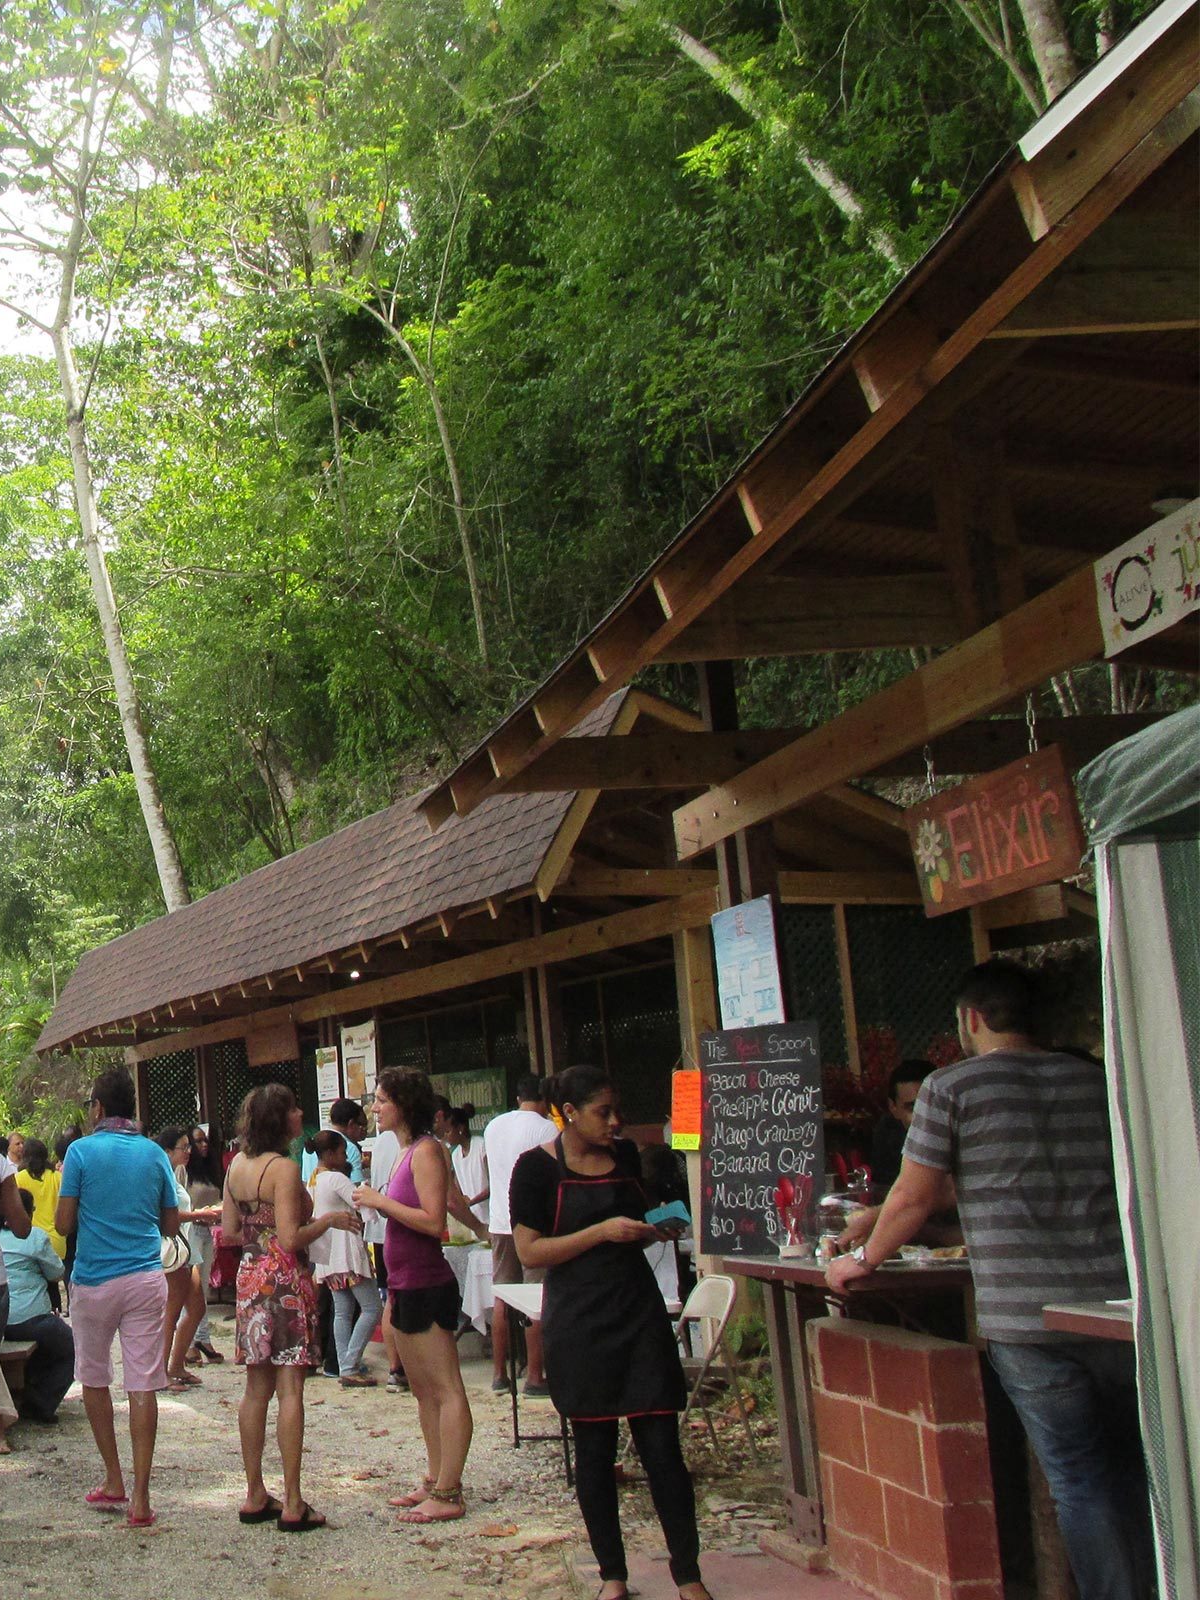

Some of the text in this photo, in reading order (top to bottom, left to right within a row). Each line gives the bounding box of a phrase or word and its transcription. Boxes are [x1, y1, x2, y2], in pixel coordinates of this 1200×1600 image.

[1118, 579, 1149, 607] ALIVE
[946, 778, 1060, 889] Elixir
[703, 1033, 817, 1060] The Red Spoon
[708, 1073, 747, 1092] Bacon
[757, 1069, 800, 1089] Cheese
[708, 1093, 769, 1121] Pineapple
[710, 1117, 818, 1150] Mango Cranberry
[708, 1147, 815, 1178] Banana Oat
